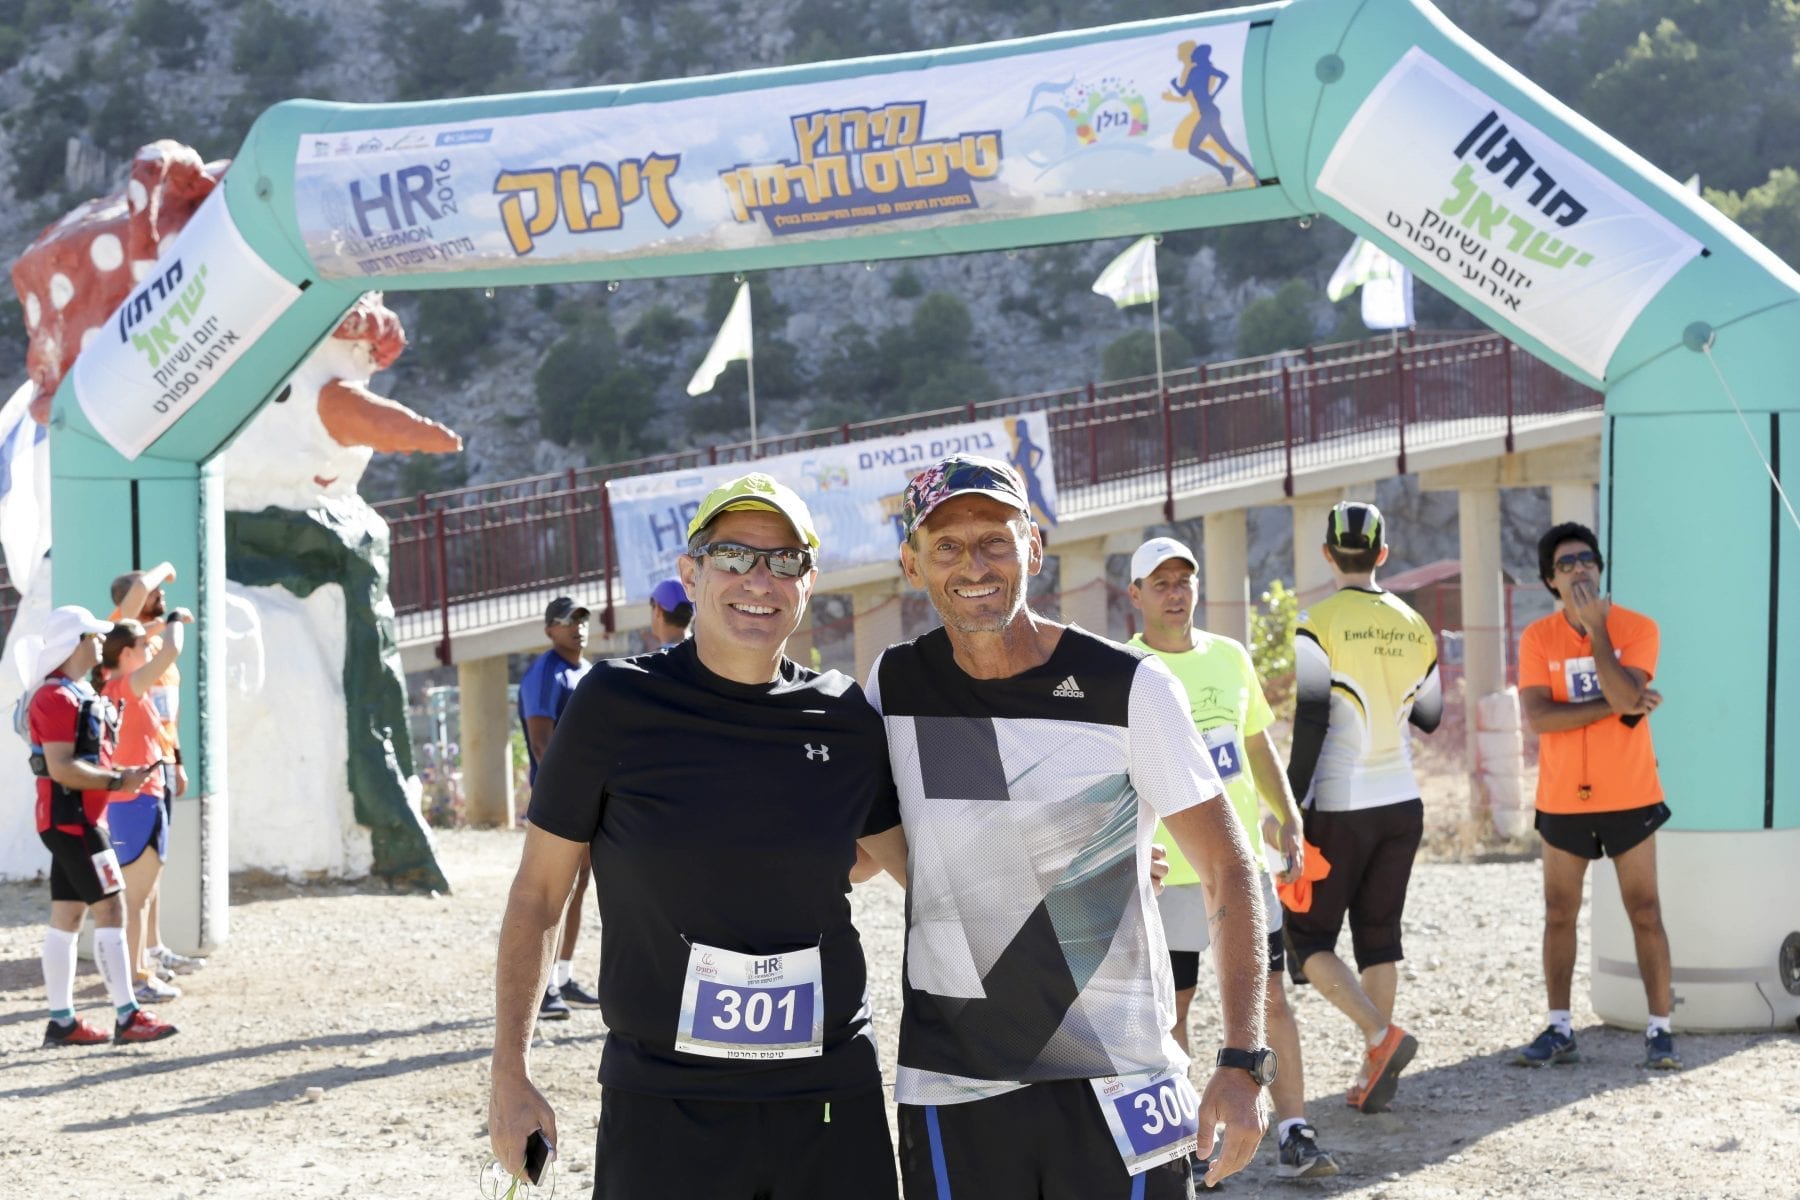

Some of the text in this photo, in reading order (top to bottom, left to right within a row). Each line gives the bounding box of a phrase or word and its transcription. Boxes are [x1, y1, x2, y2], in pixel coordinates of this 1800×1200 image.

[791, 101, 925, 165] מירוץ
[1096, 110, 1129, 133] גולן
[350, 164, 443, 238] HR
[435, 158, 459, 217] 2016
[492, 151, 683, 257] זינוק
[720, 133, 1002, 222] טיפוס חרמון
[1453, 110, 1588, 228] מרתון
[366, 225, 434, 252] HERMON
[433, 236, 475, 262] מירוץ
[1419, 208, 1533, 289] יזום ושיווק
[1439, 163, 1595, 269] ישראל
[1386, 210, 1522, 311] אירועי ספורט
[119, 257, 184, 344] מרתון
[130, 262, 208, 369] ישראל
[153, 315, 219, 389] יזום ושיווק
[153, 329, 241, 414] אירועי ספורט
[859, 431, 995, 470] ברוכים הבאים
[1053, 689, 1085, 698] adidas
[754, 957, 779, 975] HR
[712, 989, 796, 1032] 301
[1134, 1077, 1197, 1135] 300
